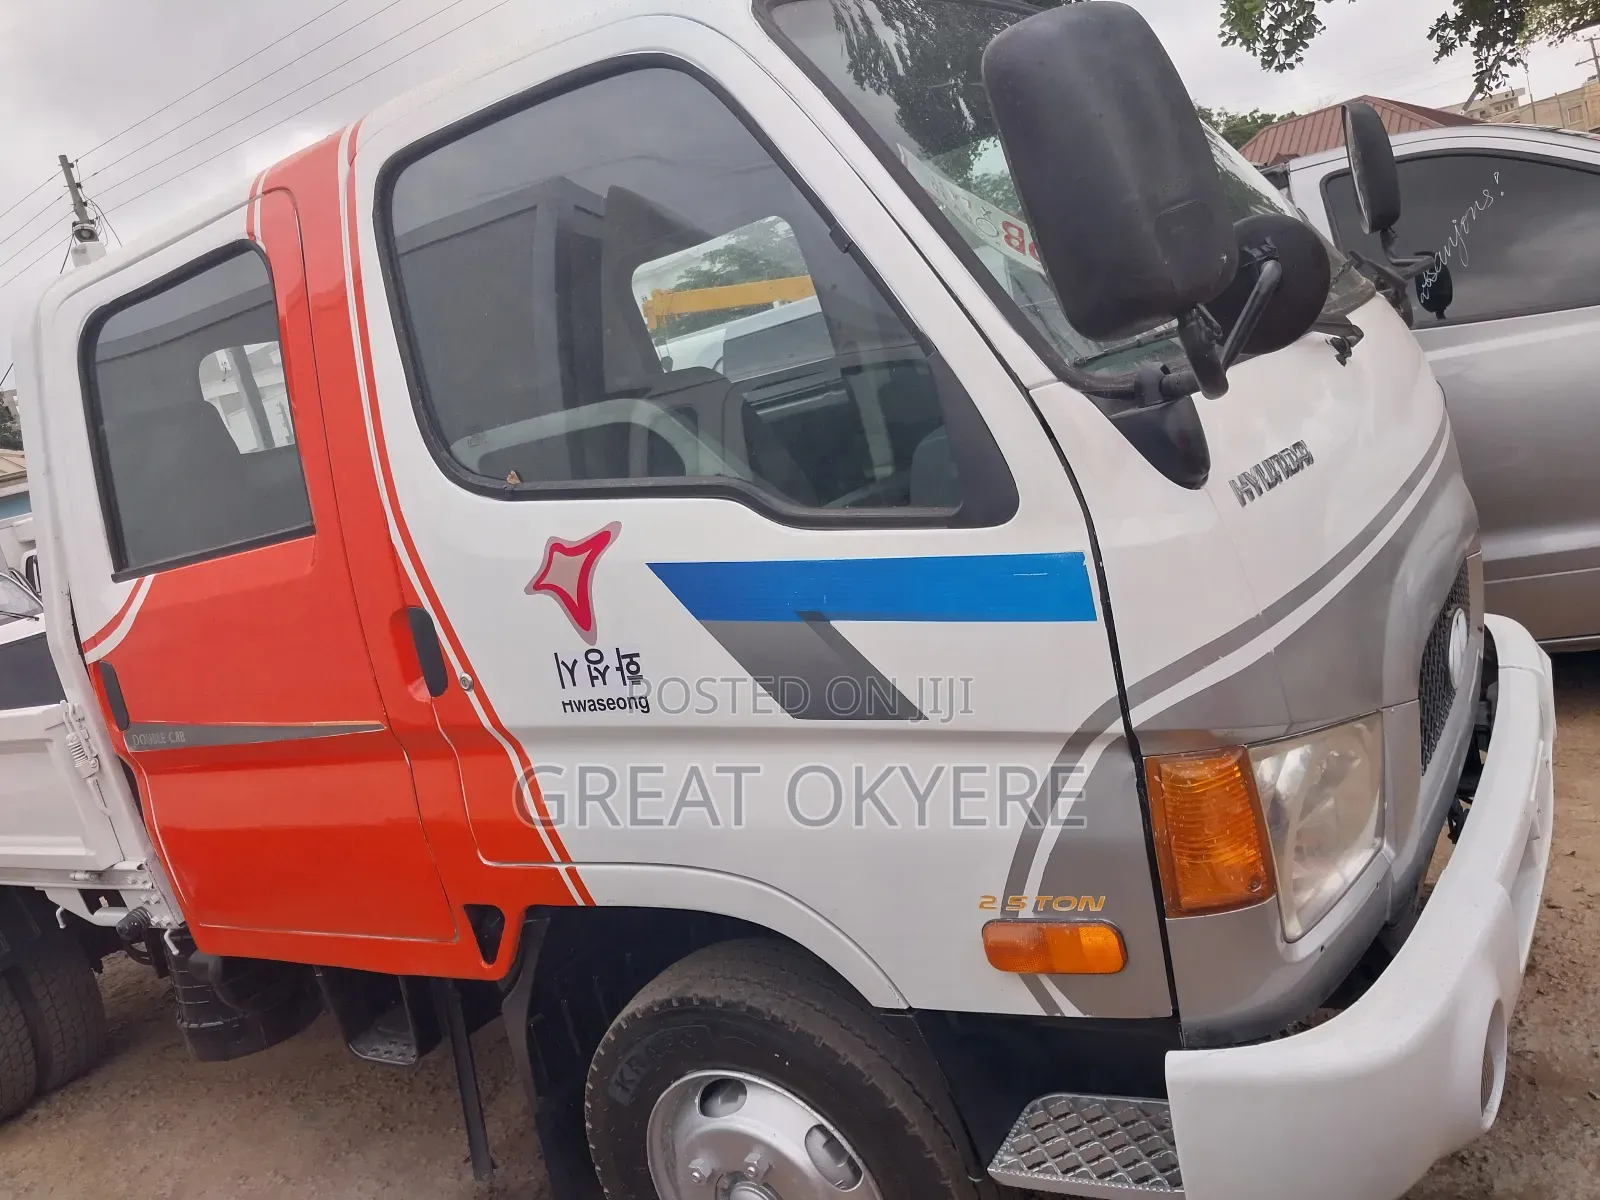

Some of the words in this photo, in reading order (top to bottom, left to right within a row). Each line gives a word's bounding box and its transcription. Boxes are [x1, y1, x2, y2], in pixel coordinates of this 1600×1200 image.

[562, 696, 650, 713] Hwaseong
[132, 733, 167, 745] DOUBLE
[168, 731, 186, 743] CAB
